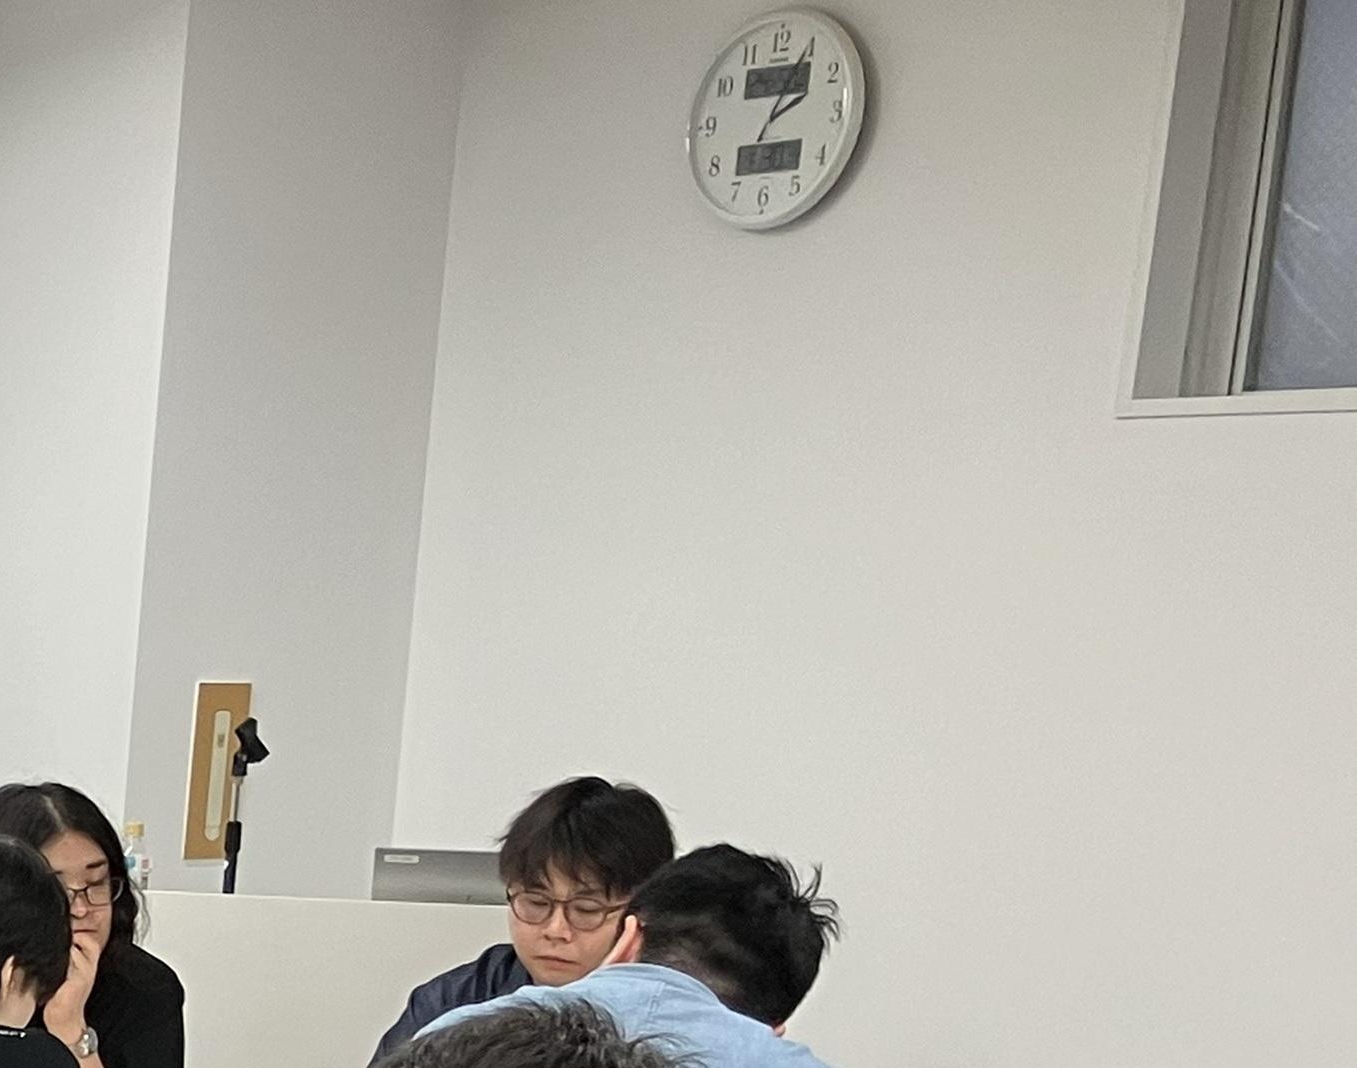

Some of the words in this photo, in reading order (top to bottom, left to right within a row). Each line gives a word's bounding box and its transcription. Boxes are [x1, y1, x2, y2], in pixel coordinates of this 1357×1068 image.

[772, 30, 791, 53] 12
[742, 44, 758, 66] 11
[827, 62, 839, 83] 2
[716, 76, 733, 98] 10
[829, 101, 842, 123] 3
[705, 116, 717, 137] 9
[708, 155, 720, 177] 8
[815, 144, 827, 166] 4
[731, 181, 741, 202] 7
[757, 186, 769, 207] 6
[788, 175, 800, 196] 5
